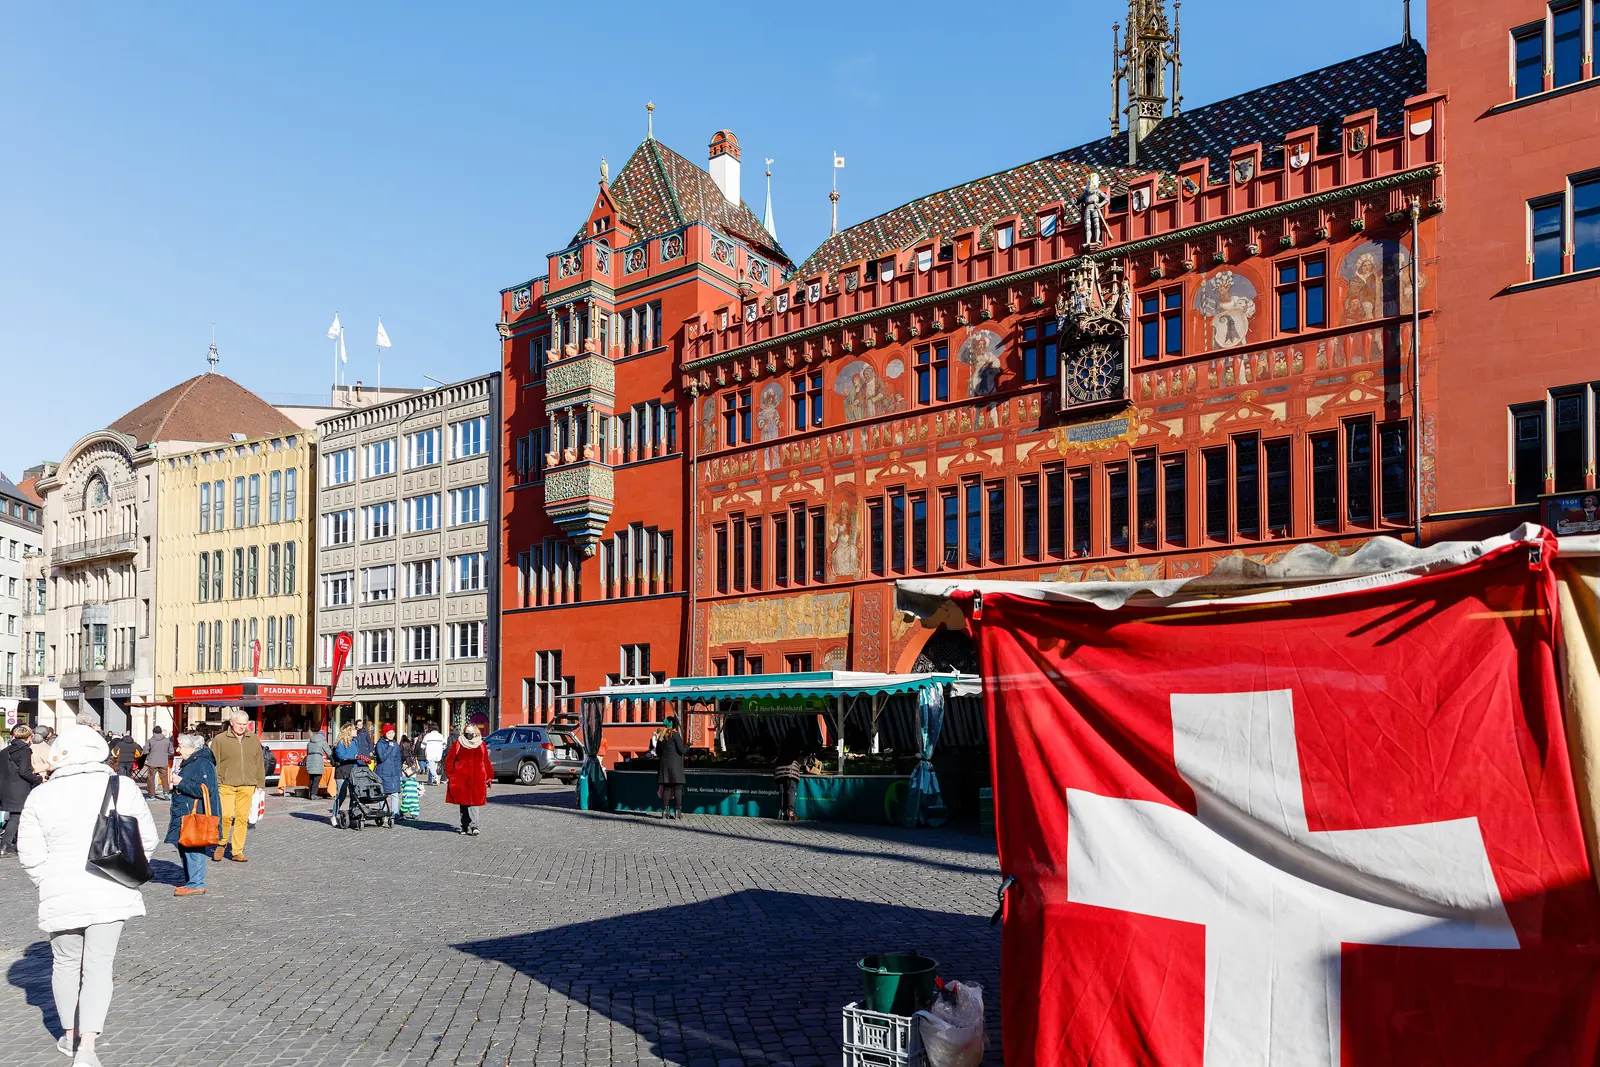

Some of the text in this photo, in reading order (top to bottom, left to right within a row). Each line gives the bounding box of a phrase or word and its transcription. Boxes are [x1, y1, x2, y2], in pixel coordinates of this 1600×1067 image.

[357, 671, 395, 689] TALLY
[111, 687, 131, 695] GLOBUS
[263, 687, 297, 695] PIADINA
